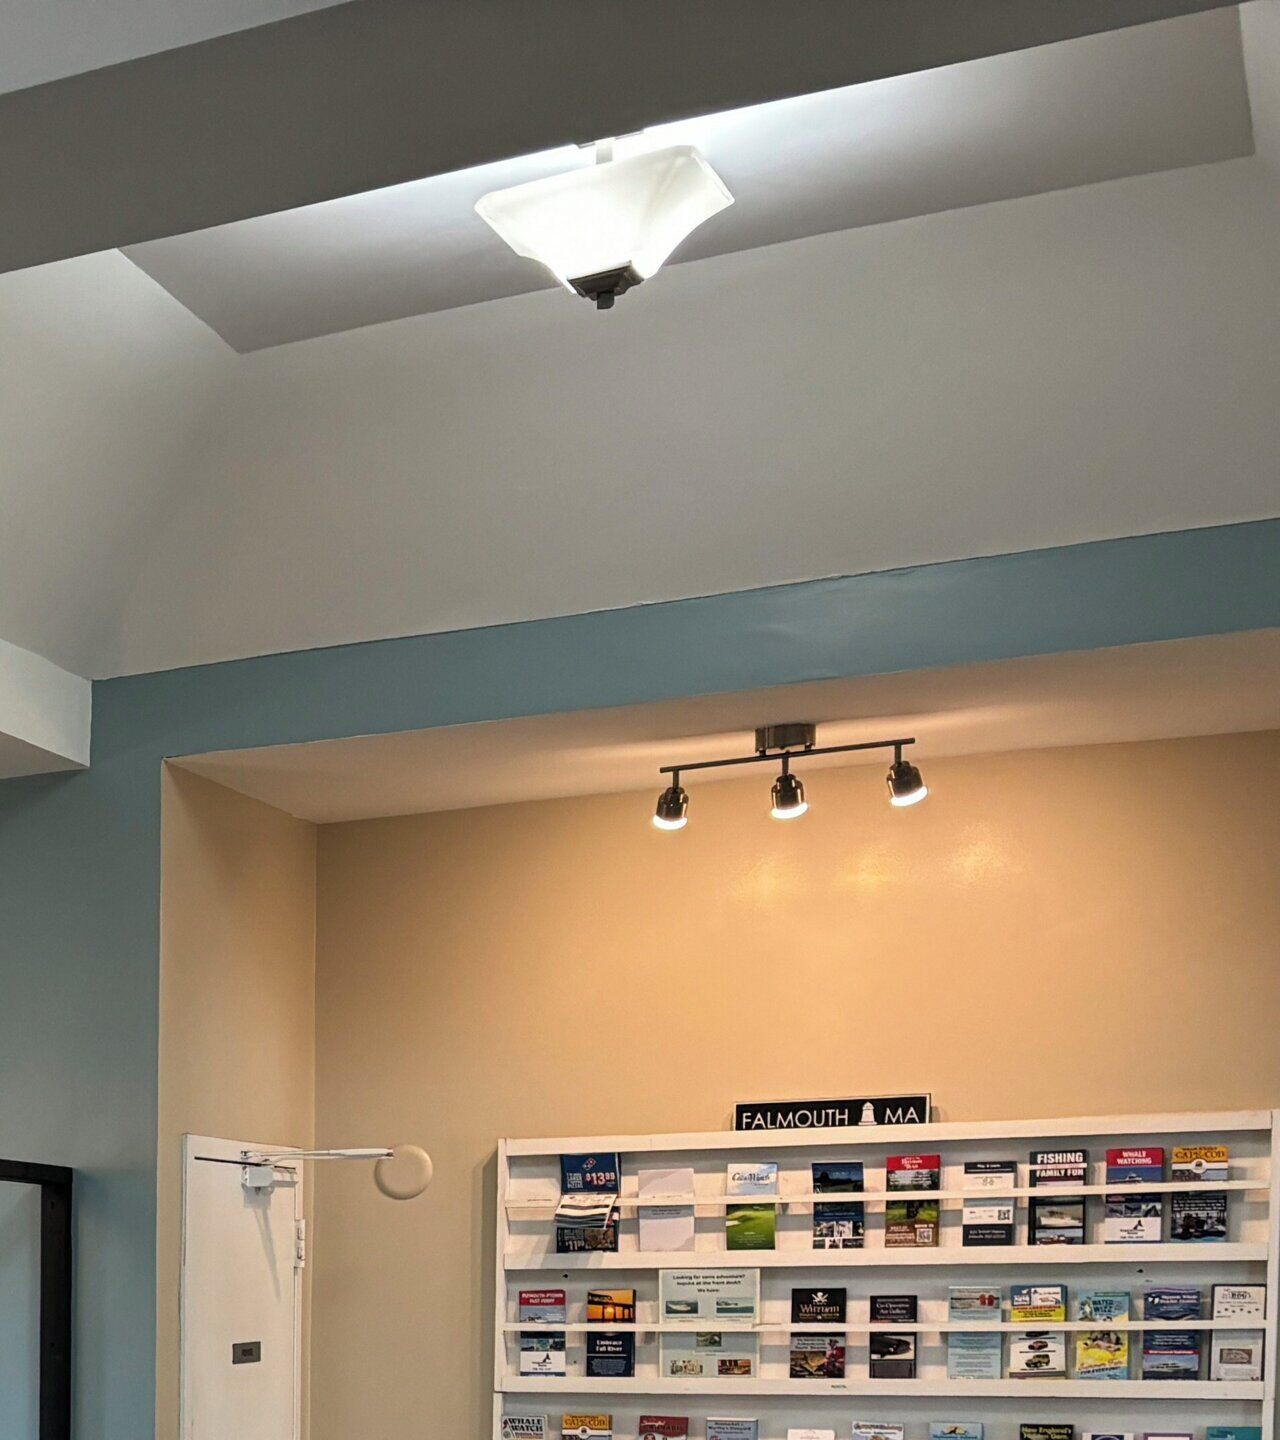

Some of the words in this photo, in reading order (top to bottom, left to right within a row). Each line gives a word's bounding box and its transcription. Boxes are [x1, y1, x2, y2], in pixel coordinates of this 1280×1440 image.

[742, 1109, 849, 1129] FALMOUTH
[884, 1106, 920, 1124] MA
[1037, 1152, 1083, 1164] FISHING
[1036, 1169, 1065, 1177] FAMILY
